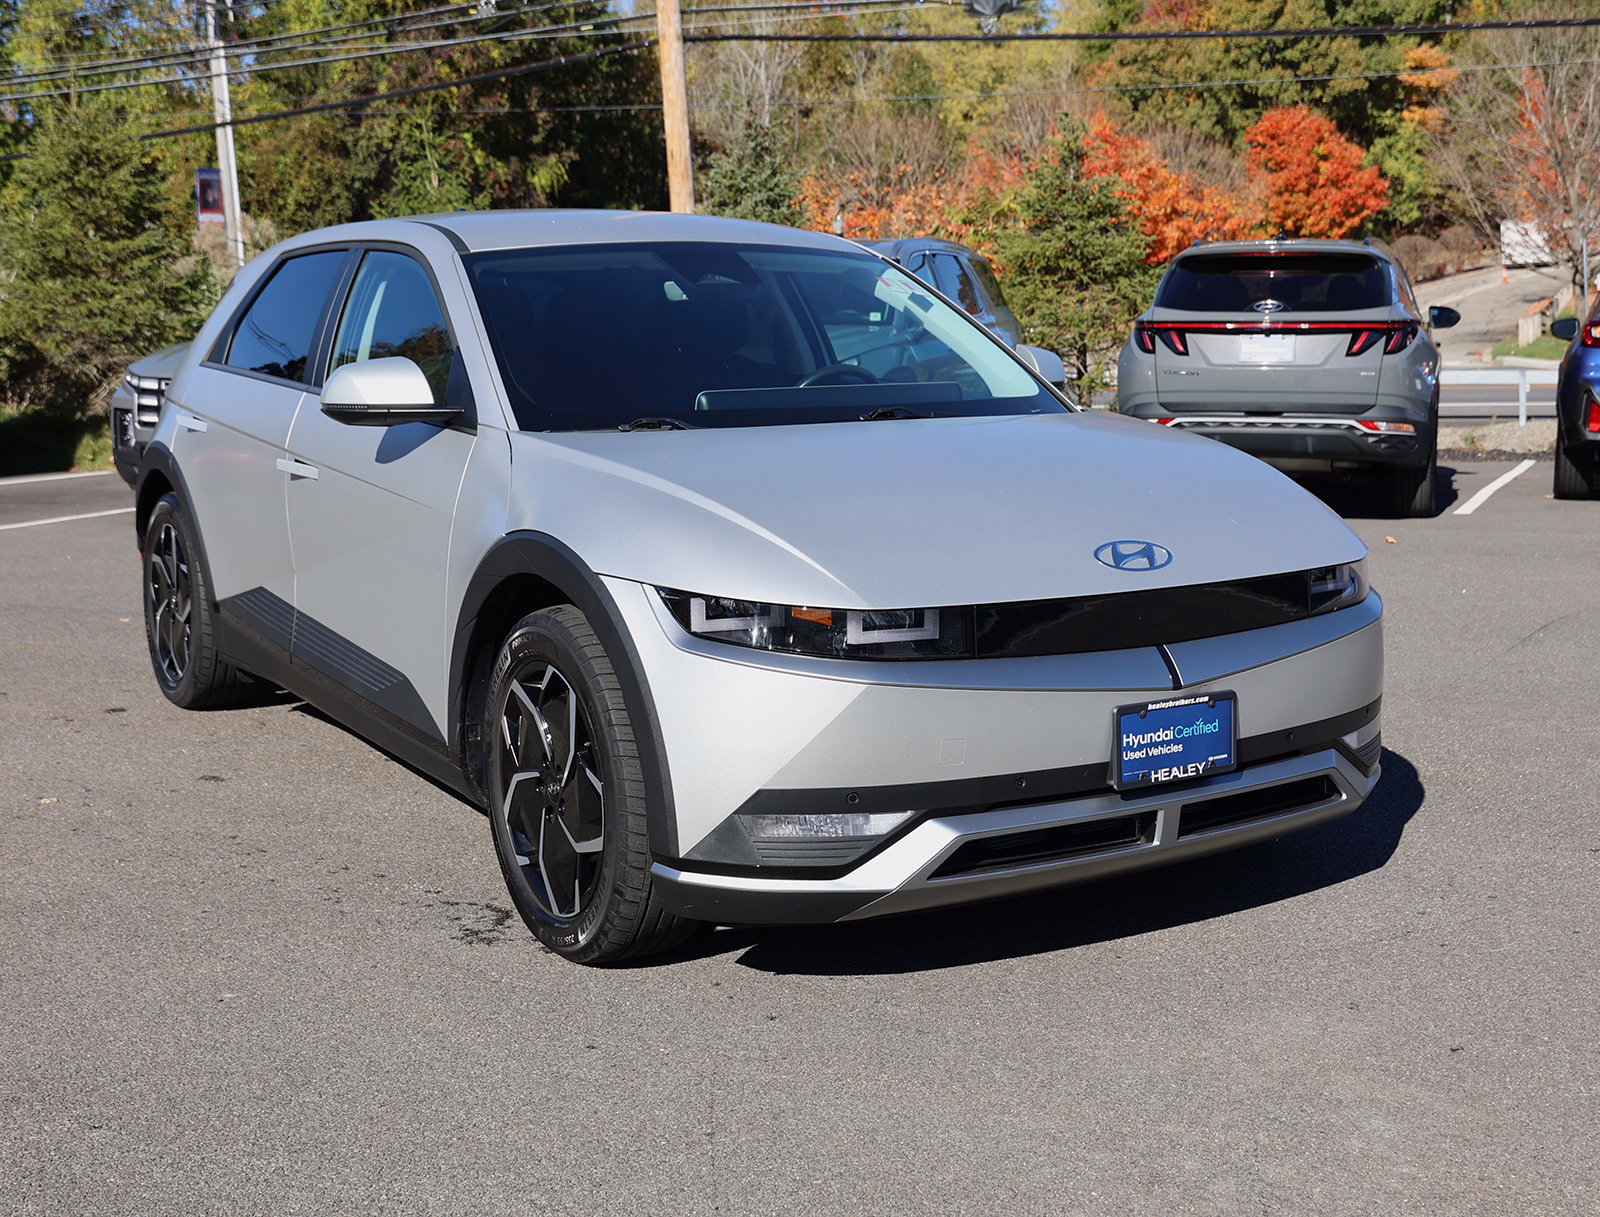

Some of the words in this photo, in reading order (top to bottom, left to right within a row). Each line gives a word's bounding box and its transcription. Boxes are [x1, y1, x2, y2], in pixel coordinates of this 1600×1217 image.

[1147, 696, 1209, 710] healeybrothers.com
[1123, 727, 1174, 748] Hyundai
[1174, 718, 1219, 738] Certified
[1123, 748, 1146, 761] Used
[1147, 743, 1183, 757] Vehicles
[1151, 761, 1206, 782] HEALEY
